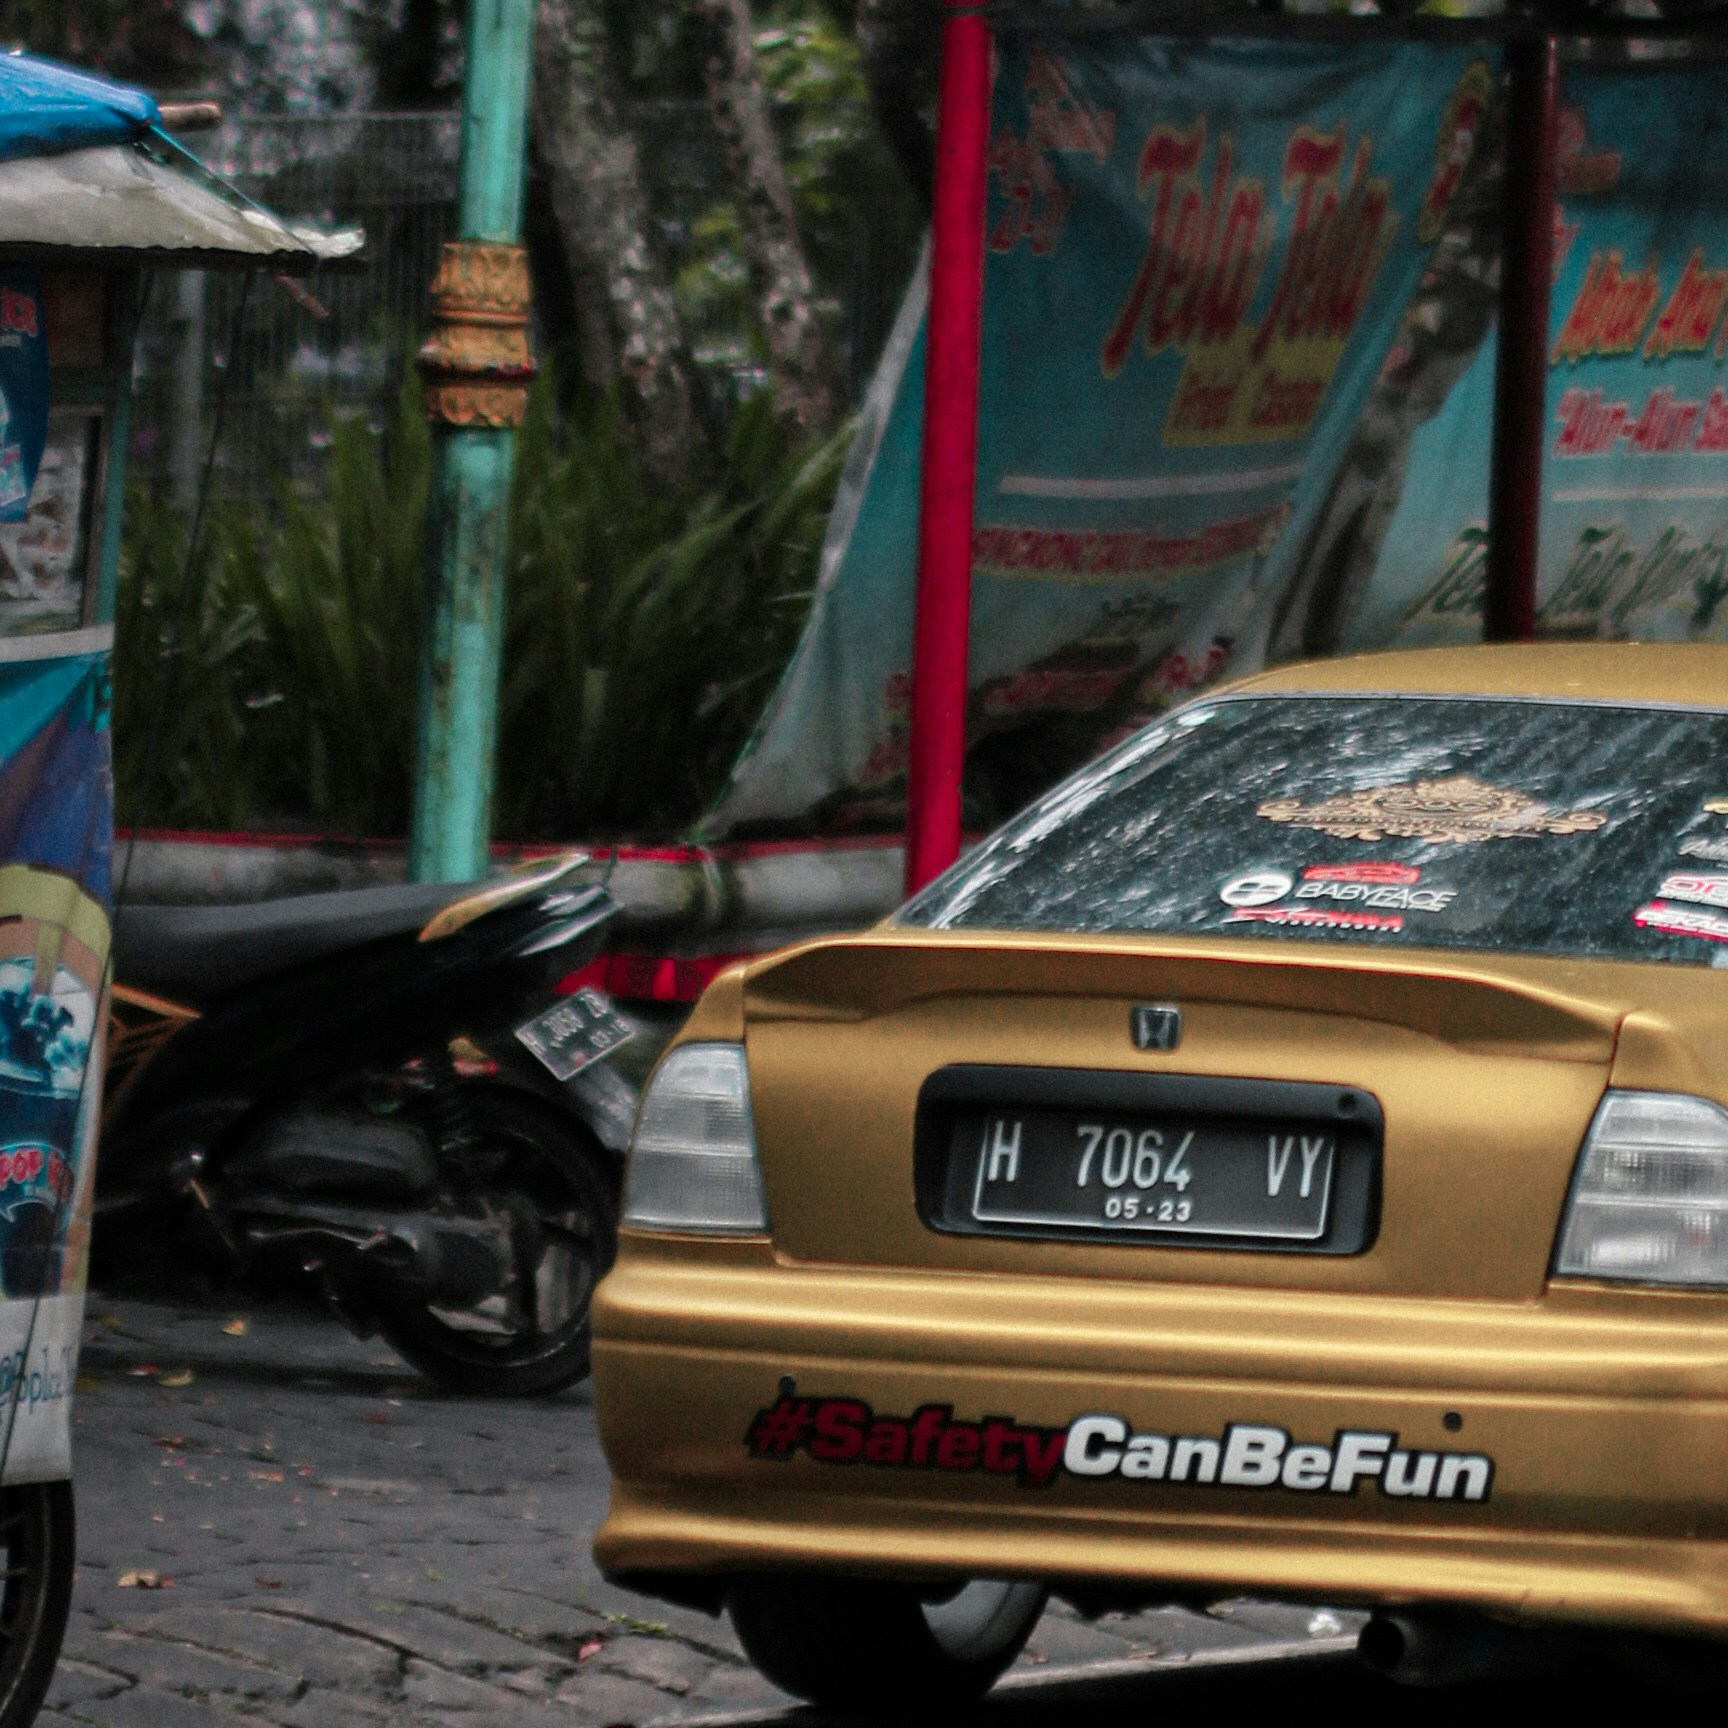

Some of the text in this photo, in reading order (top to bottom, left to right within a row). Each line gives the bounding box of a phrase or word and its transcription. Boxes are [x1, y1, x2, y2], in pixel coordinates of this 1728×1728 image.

[987, 1121, 1325, 1198] H 7064 VY
